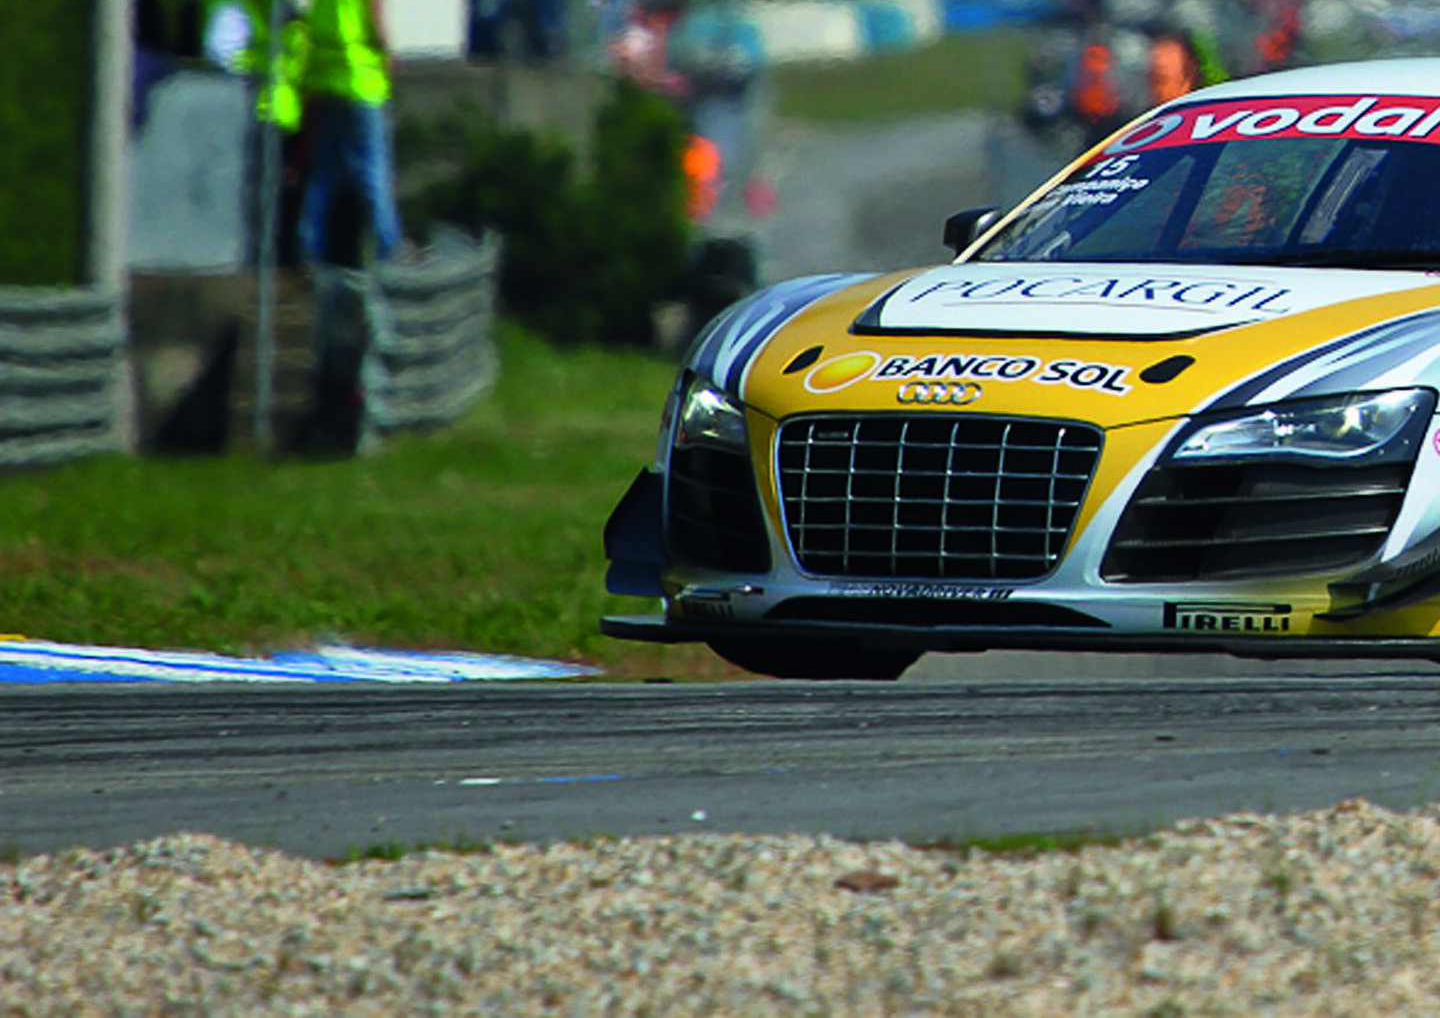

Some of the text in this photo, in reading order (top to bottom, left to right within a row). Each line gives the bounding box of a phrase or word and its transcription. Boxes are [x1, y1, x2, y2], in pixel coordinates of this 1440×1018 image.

[1085, 154, 1141, 178] 15
[910, 279, 1292, 314] POCARGIL
[875, 356, 1132, 393] BANCO SOL
[1163, 601, 1292, 632] PIRELLI
